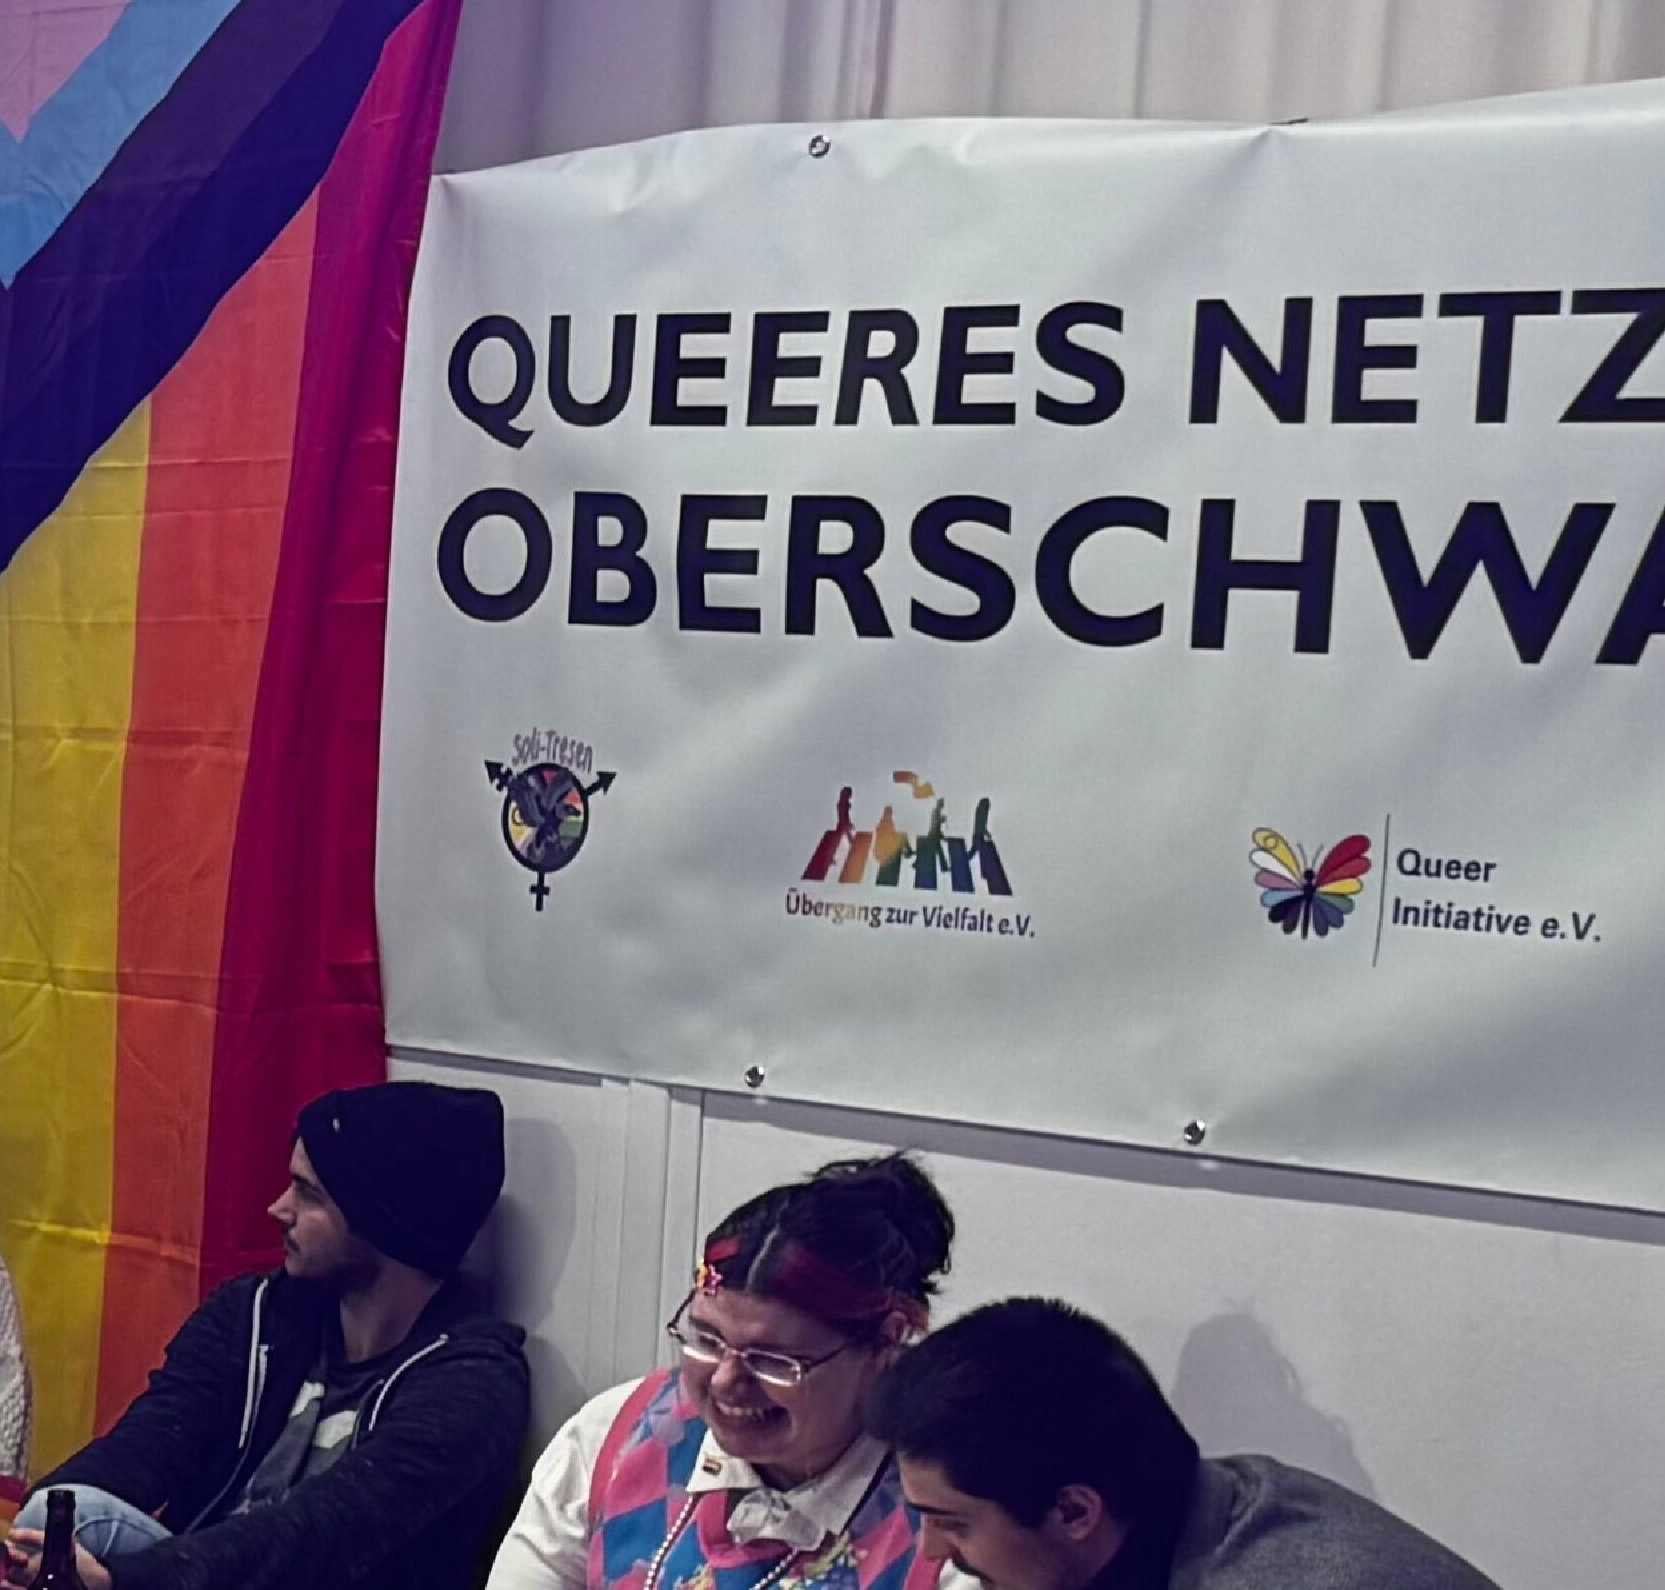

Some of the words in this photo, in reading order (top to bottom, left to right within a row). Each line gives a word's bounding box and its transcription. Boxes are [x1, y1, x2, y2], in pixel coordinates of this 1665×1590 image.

[447, 302, 1125, 449] QUEERES
[1189, 287, 1665, 425] NETZ
[1397, 848, 1498, 883] Queer
[785, 887, 882, 928] Übergang
[884, 906, 919, 926] zur
[922, 905, 993, 933] Vielfalt
[997, 914, 1036, 938] e.V.
[1391, 895, 1532, 936] Initiative
[1540, 911, 1602, 943] e.V.
